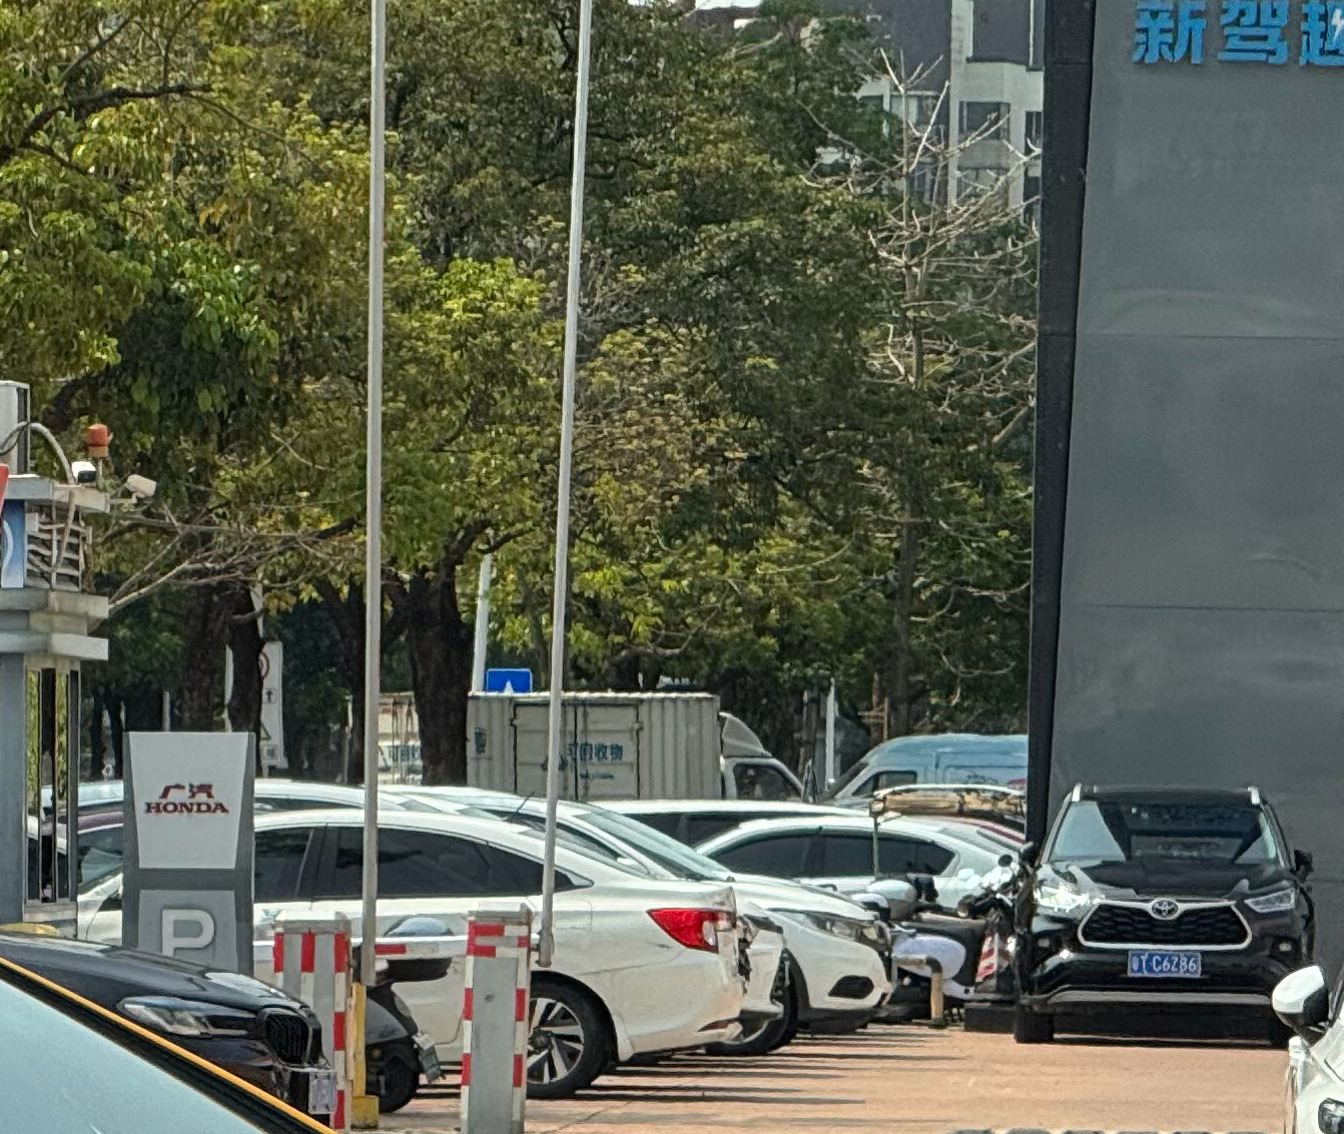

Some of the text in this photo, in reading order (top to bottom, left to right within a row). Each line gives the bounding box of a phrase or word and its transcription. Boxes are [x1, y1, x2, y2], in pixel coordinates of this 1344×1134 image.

[159, 783, 215, 799] 广汽
[144, 802, 230, 814] HONDA
[162, 909, 215, 958] P
